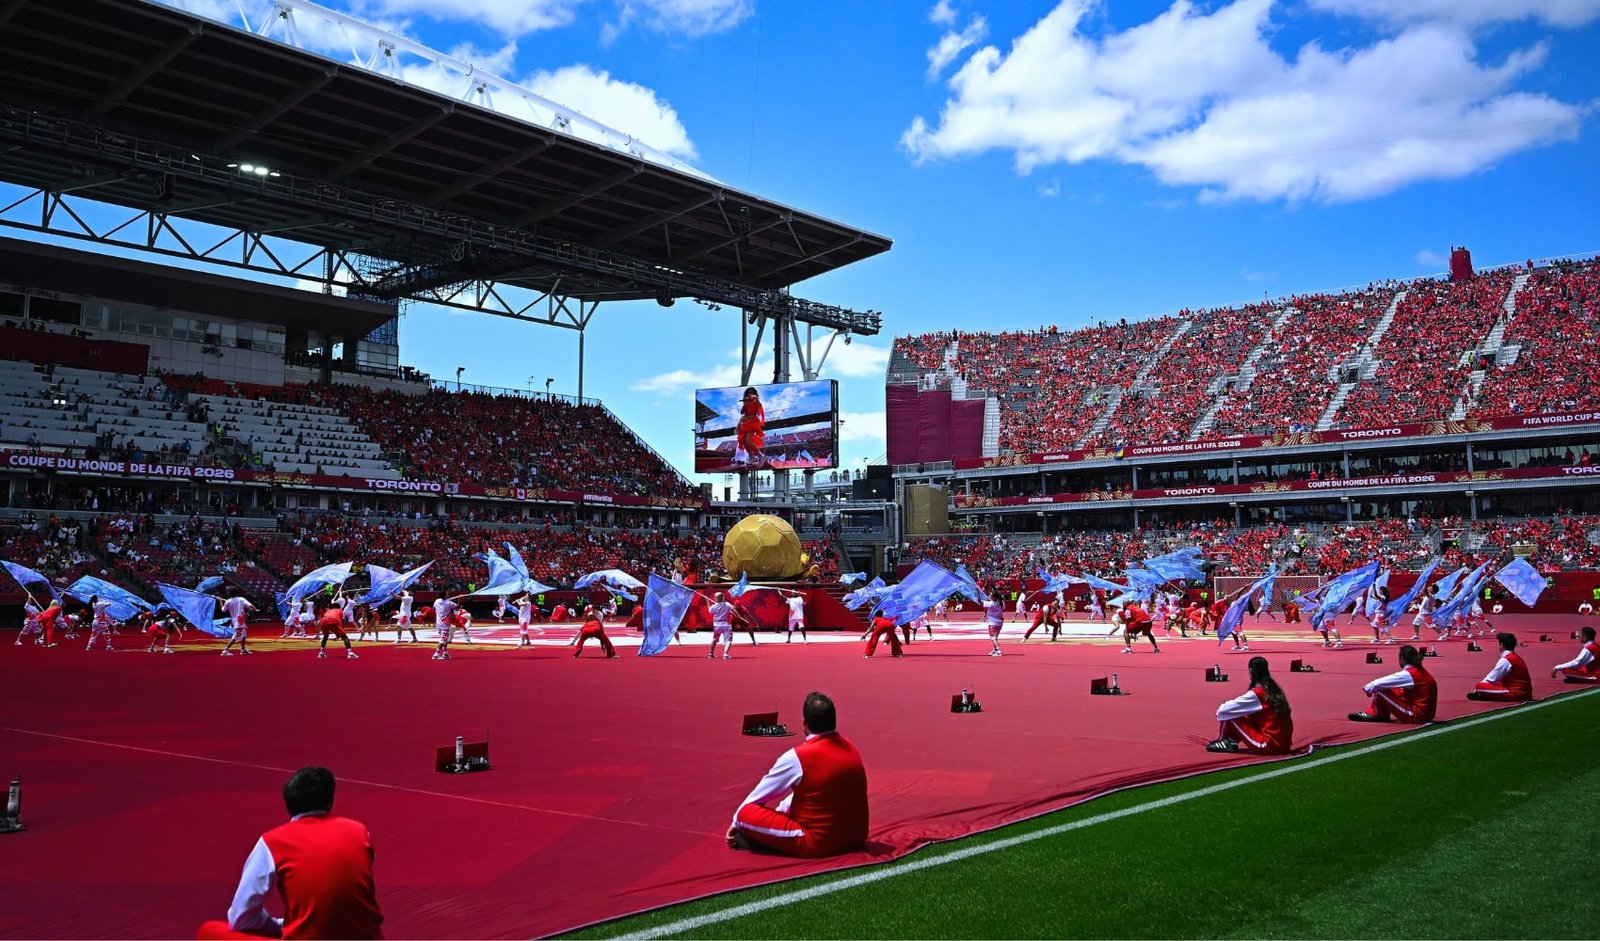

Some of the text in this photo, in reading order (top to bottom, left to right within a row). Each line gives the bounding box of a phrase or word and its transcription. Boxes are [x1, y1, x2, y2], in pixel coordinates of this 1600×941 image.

[1340, 428, 1402, 438] TORONTO
[9, 456, 234, 478] COUPE DU MONDE DE LA FIFA 2026
[1562, 466, 1600, 474] TORO
[365, 479, 440, 492] TORONTO
[1164, 488, 1216, 496] TORONTO
